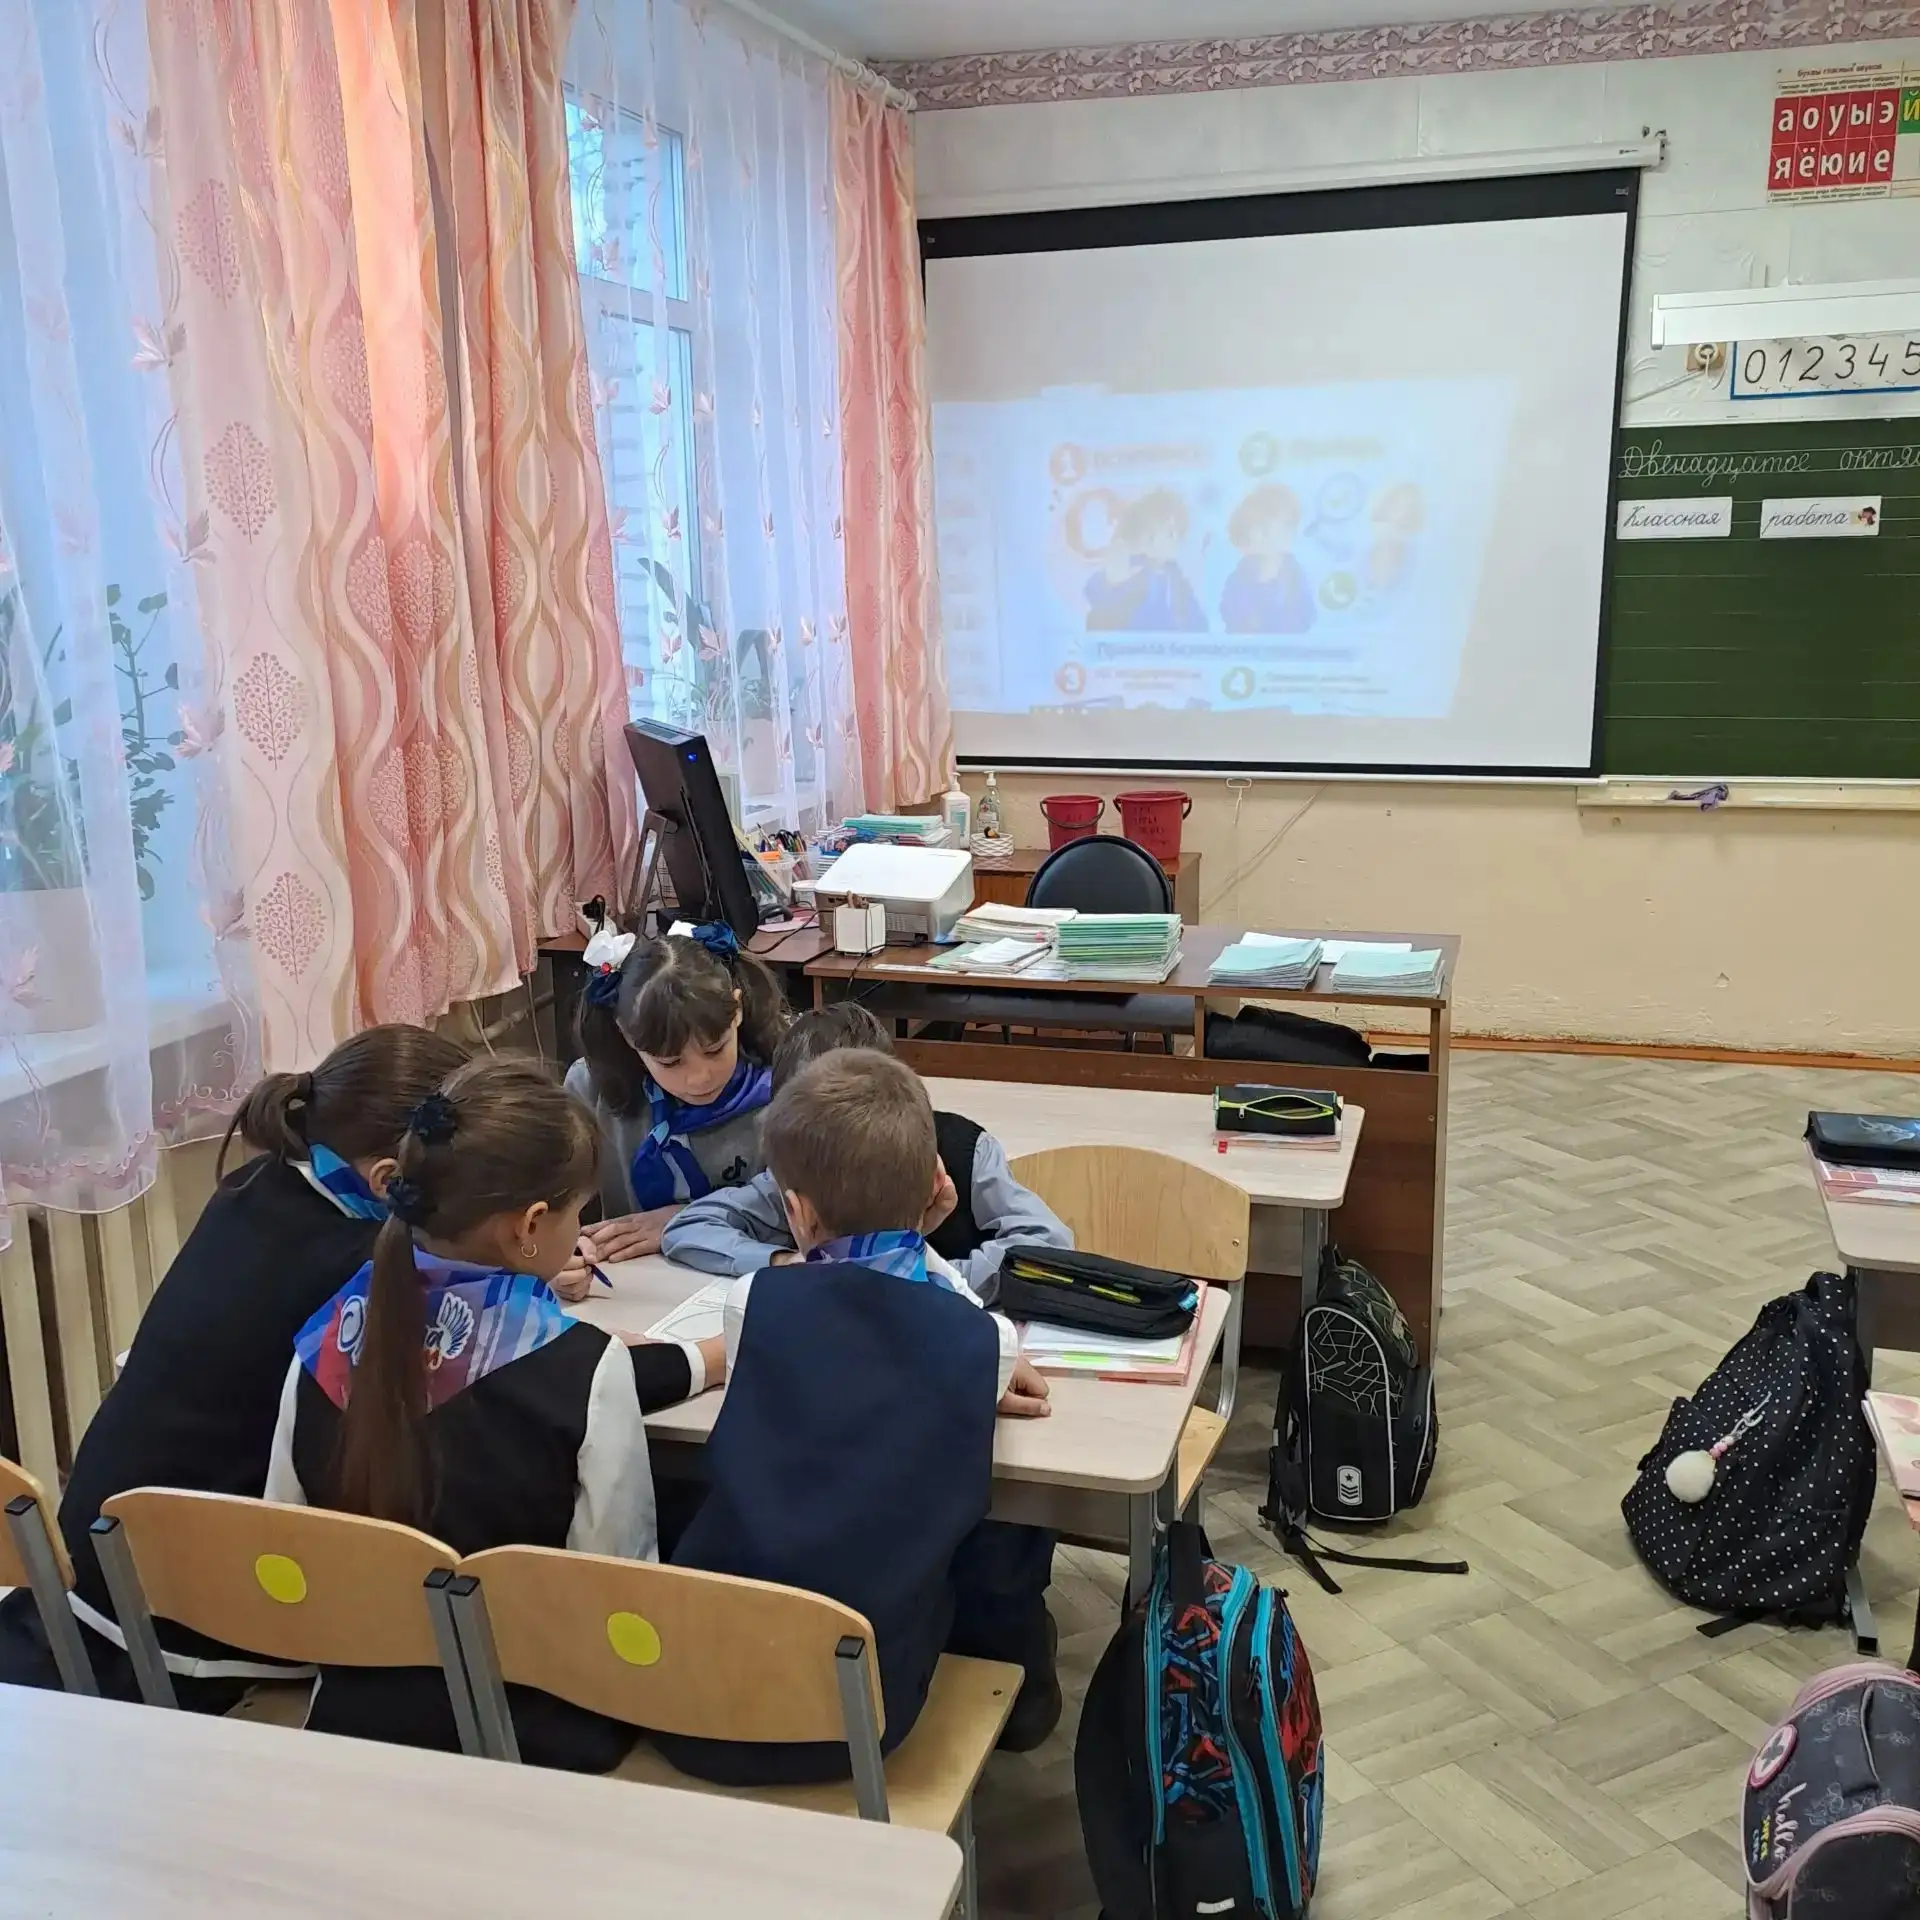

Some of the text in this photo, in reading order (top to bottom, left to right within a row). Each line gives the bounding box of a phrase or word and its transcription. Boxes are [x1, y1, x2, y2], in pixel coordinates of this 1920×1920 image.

[1619, 439, 1810, 488] Двенадцатое
[1623, 503, 1849, 536] Классная работа
